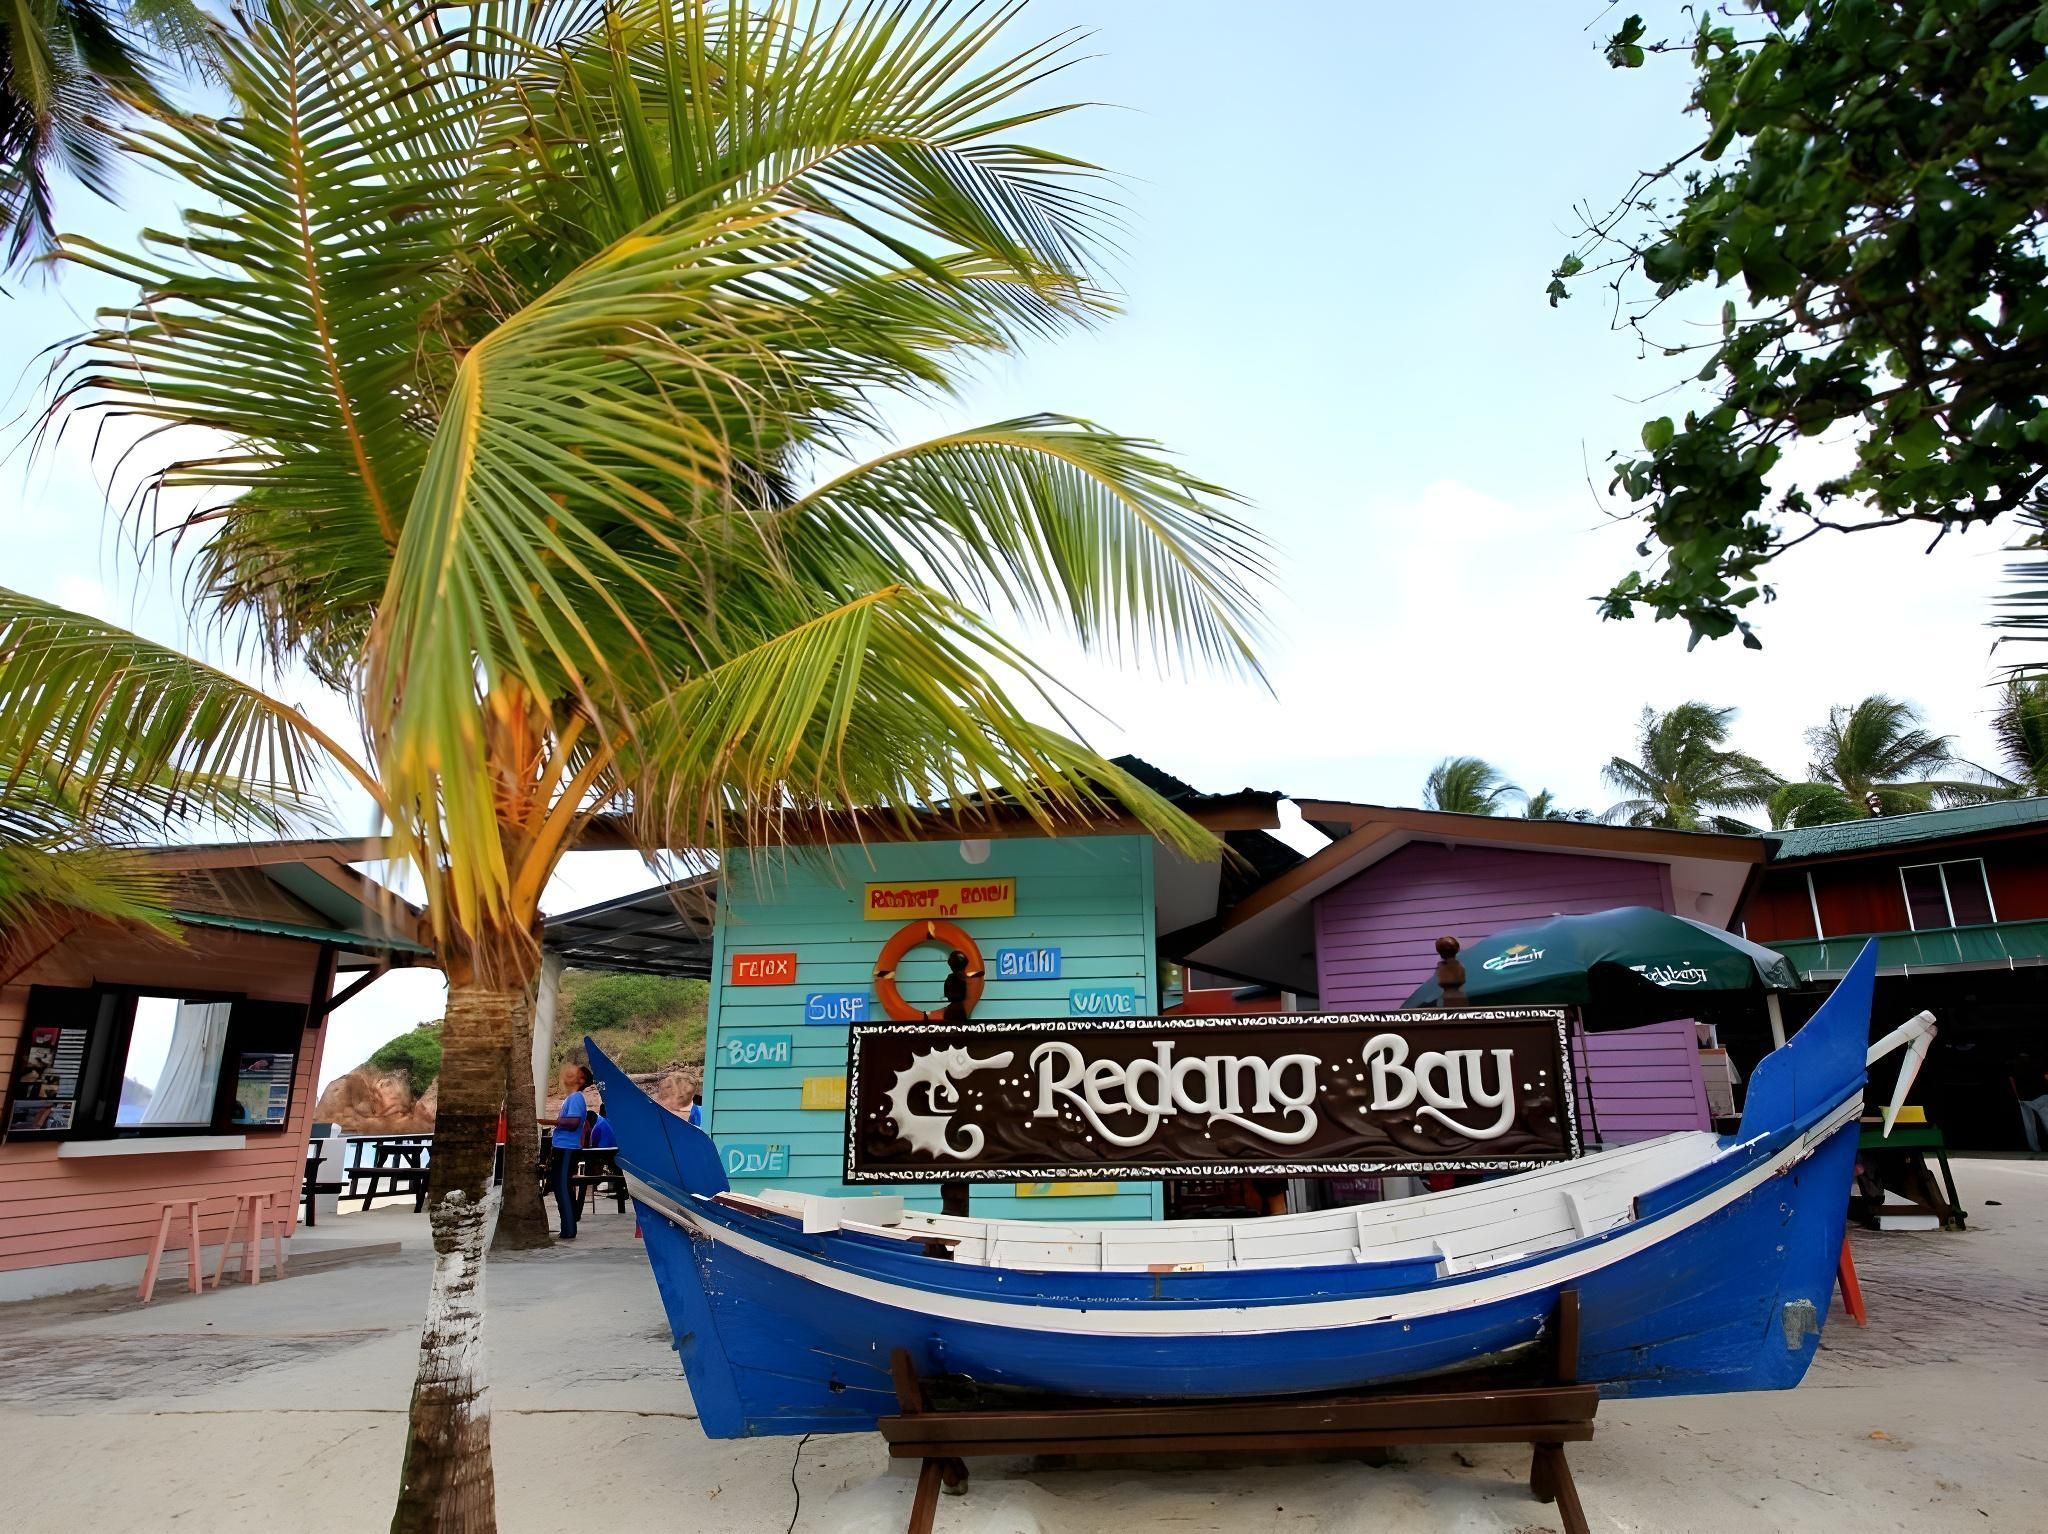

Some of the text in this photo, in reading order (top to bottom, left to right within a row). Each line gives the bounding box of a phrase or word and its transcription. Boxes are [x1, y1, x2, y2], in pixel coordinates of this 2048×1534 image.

[1029, 1033, 1516, 1147] Redang Bay
[728, 1149, 785, 1174] DIVE
